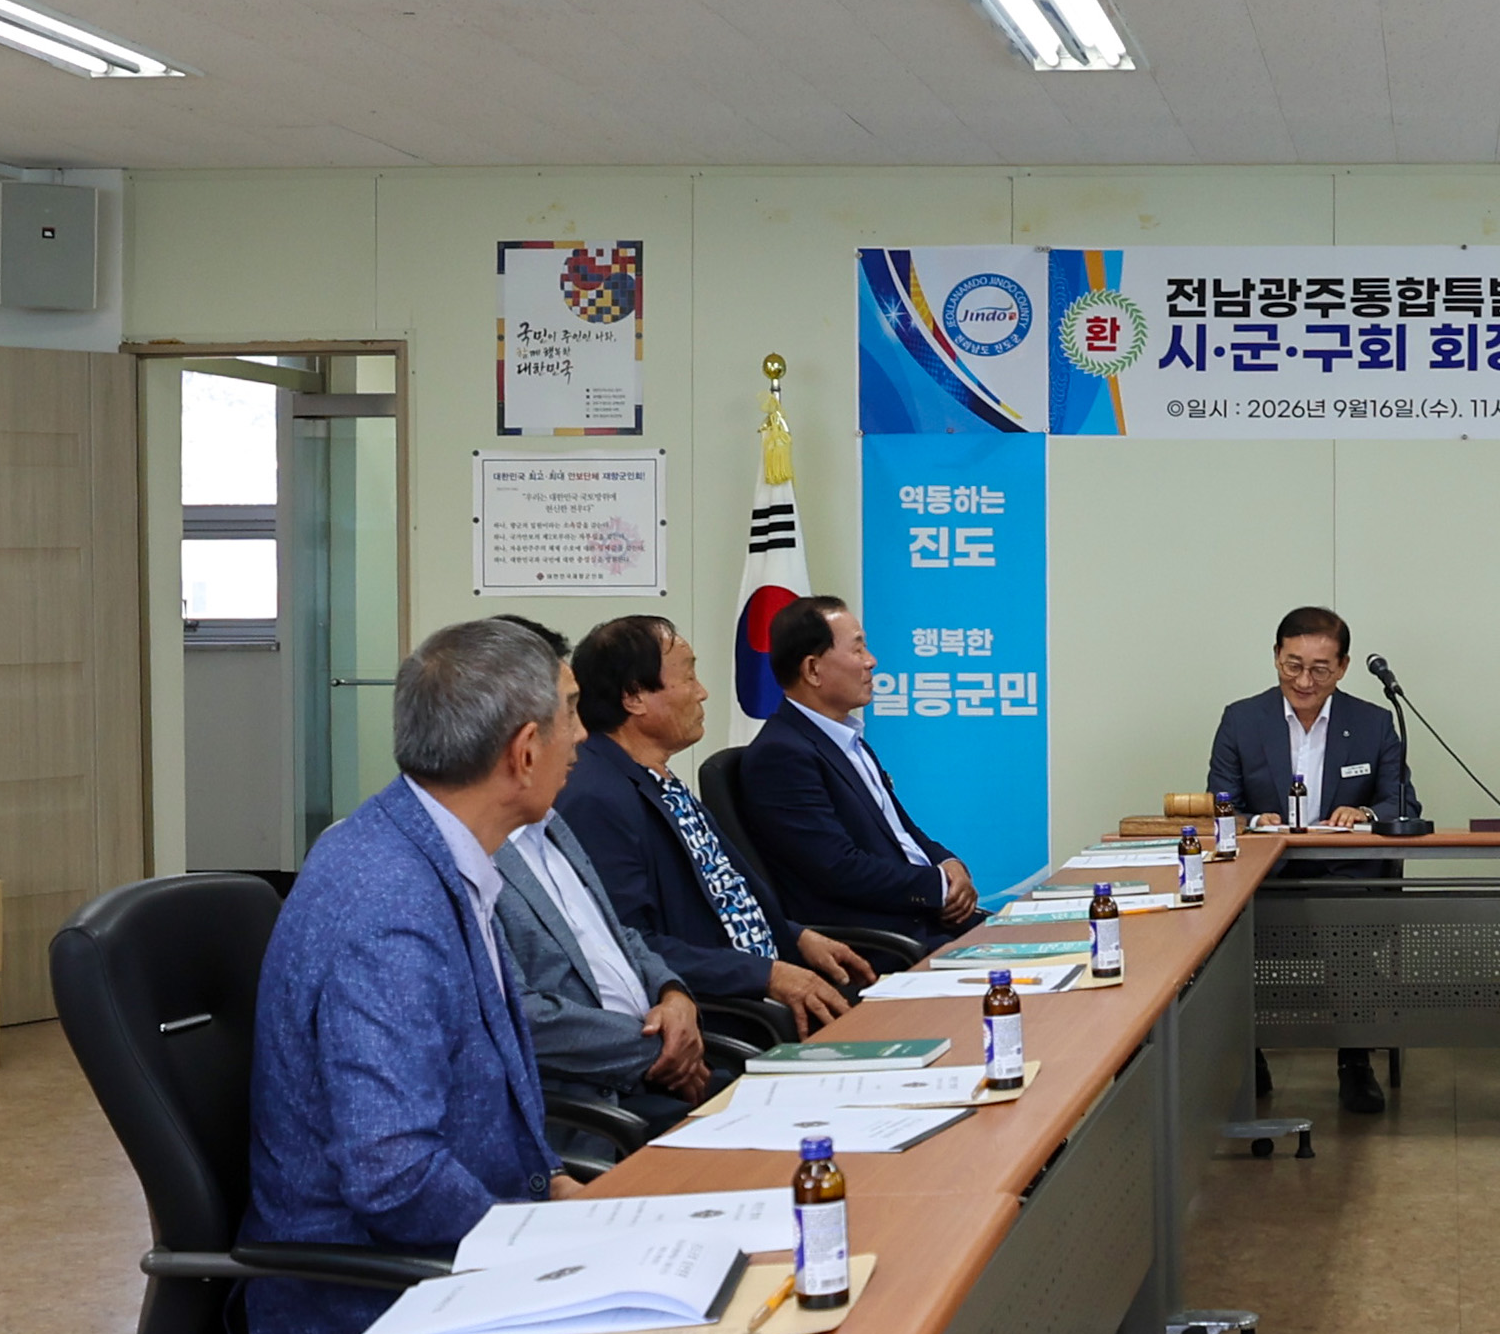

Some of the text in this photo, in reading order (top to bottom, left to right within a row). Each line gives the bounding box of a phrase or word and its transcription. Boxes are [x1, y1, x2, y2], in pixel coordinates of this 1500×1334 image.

[958, 309, 1007, 323] Jindo
[988, 276, 1018, 293] JINDO
[1014, 290, 1030, 329] COUNTY
[1085, 315, 1121, 352] 환
[1158, 323, 1407, 373] 시·군·구회
[516, 359, 574, 385] 대한민국
[1247, 398, 1327, 419] 2026년
[493, 472, 526, 481] 대한민국
[567, 472, 600, 481] 안보단체
[899, 485, 1006, 515] 역동하는
[909, 526, 997, 568] 진도
[911, 628, 995, 658] 행복한
[871, 672, 1039, 717] 일등군민
